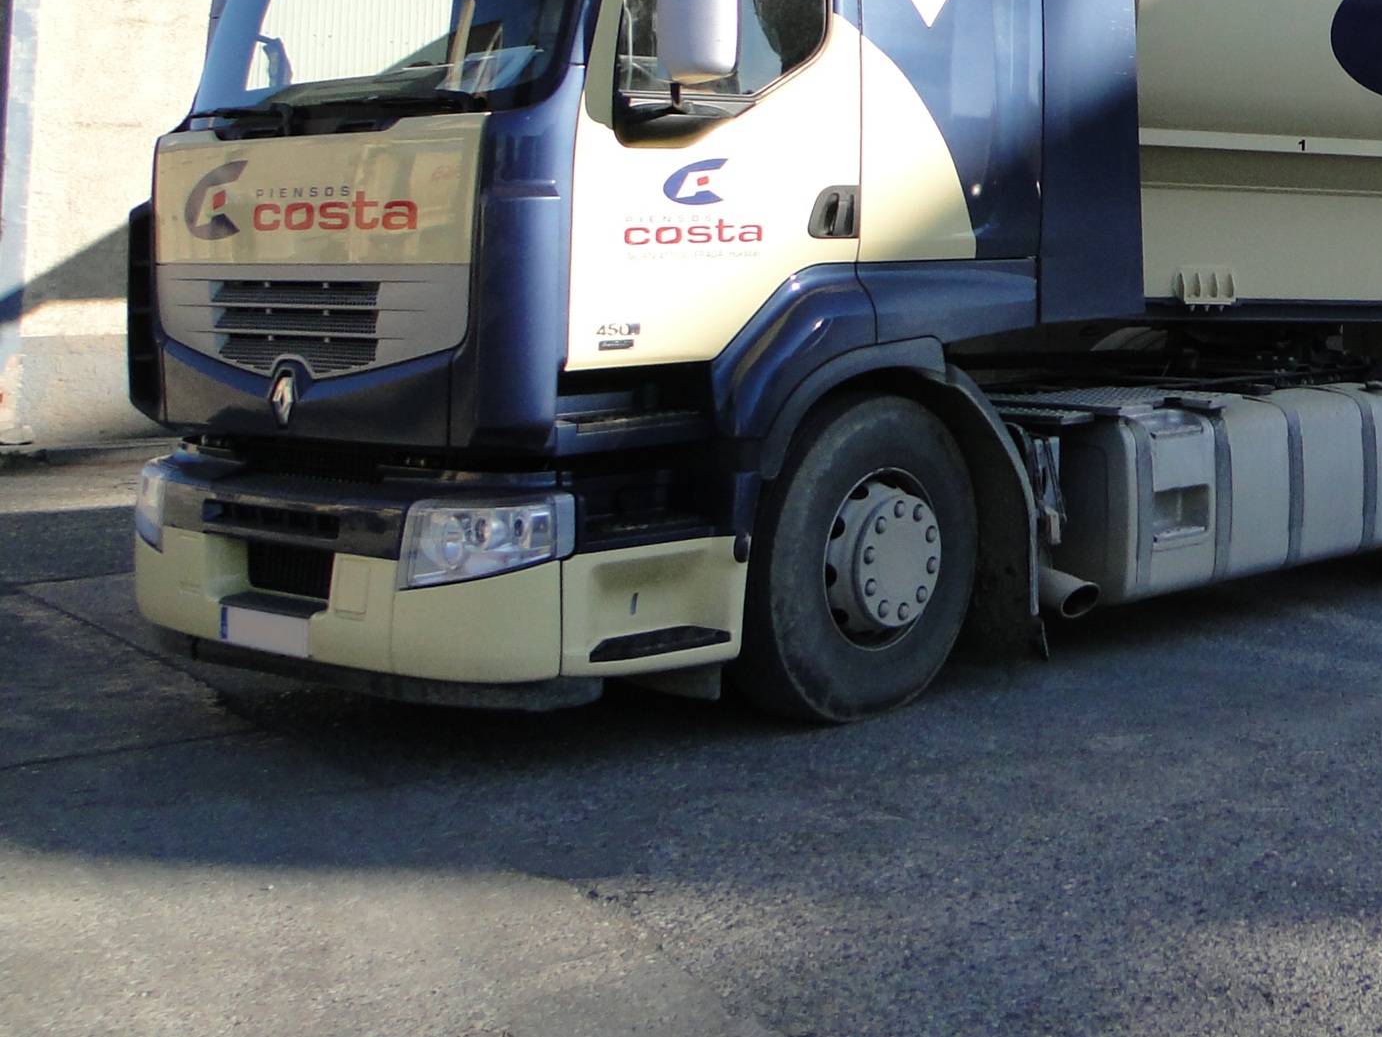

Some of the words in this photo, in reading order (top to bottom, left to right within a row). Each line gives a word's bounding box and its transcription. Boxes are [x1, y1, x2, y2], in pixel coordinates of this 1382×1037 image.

[1298, 139, 1306, 151] 1
[256, 186, 350, 198] PIENSOS
[253, 190, 418, 231] costa
[625, 215, 712, 223] PIENSOS
[624, 218, 763, 245] costa
